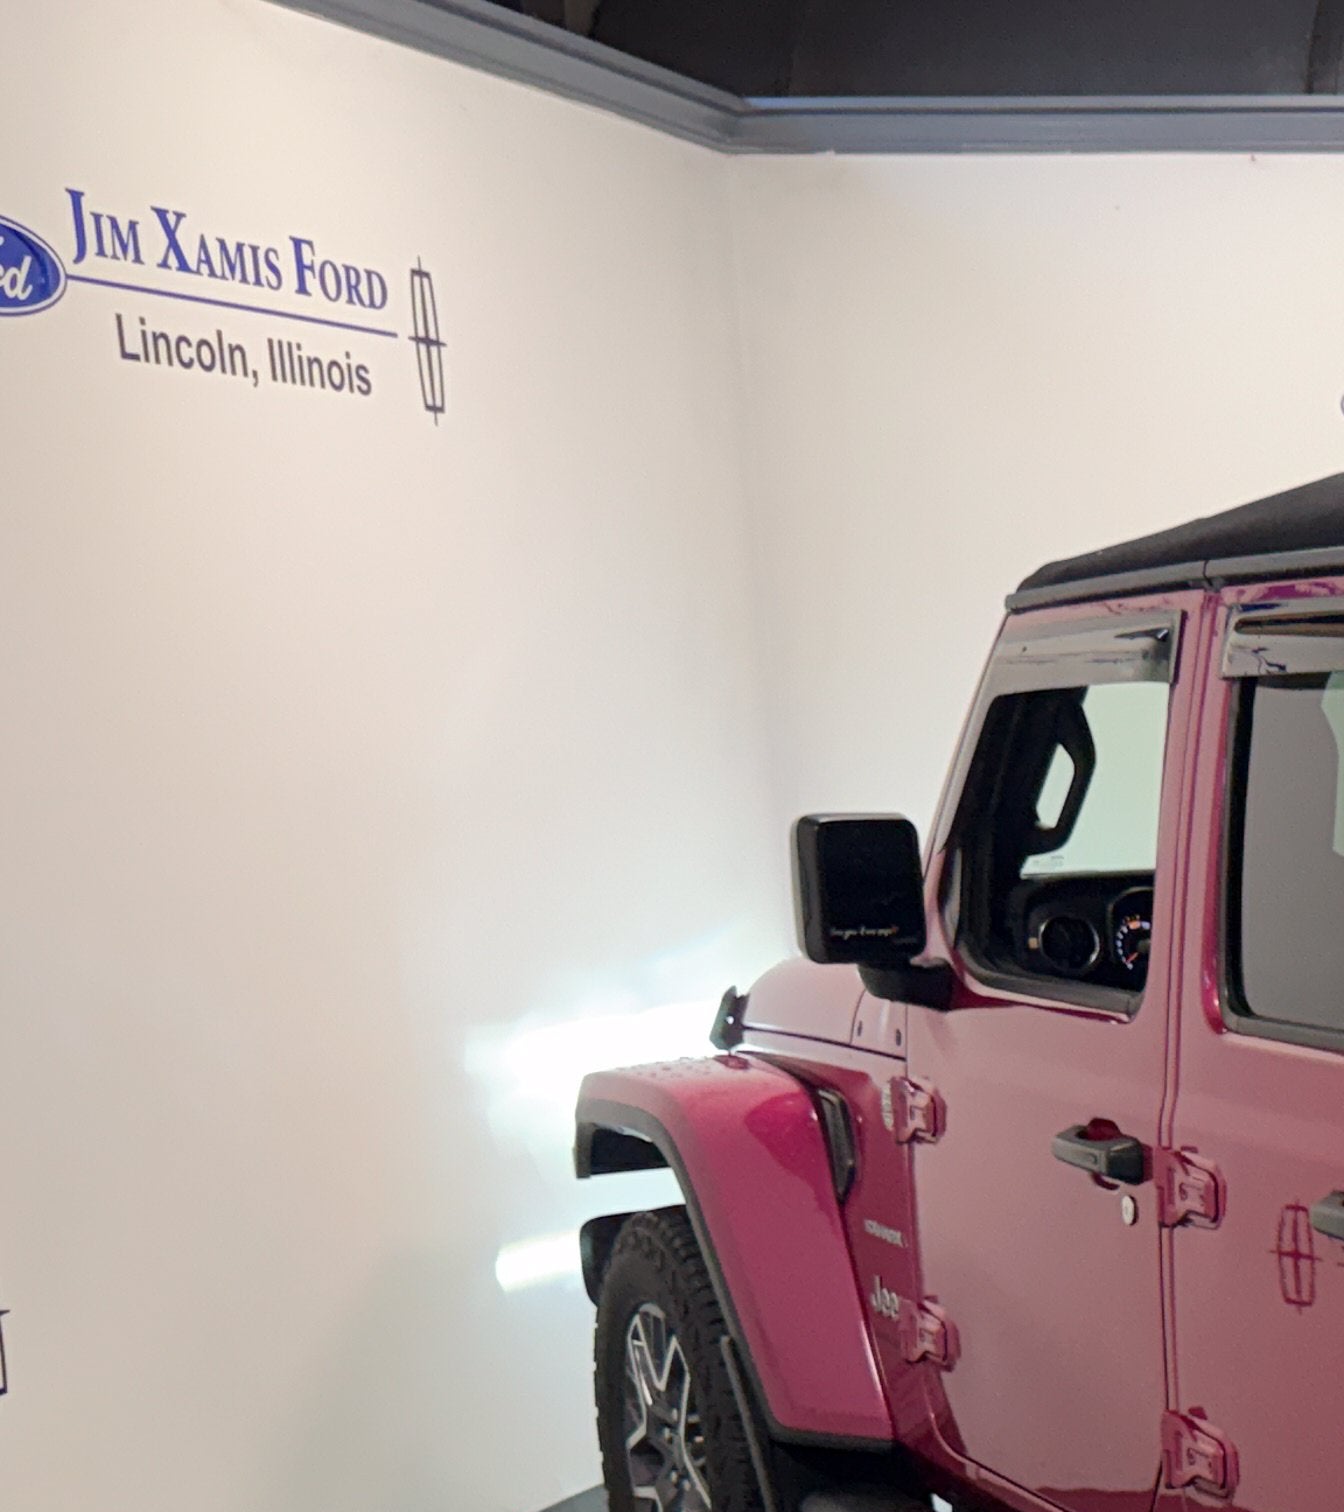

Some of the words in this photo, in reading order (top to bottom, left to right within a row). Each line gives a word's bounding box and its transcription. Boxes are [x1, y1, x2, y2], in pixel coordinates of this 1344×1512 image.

[65, 188, 145, 265] JIM
[151, 206, 283, 292] XAMIS
[289, 236, 389, 310] FORD
[115, 313, 260, 387] Lincoln,
[267, 338, 373, 397] Illinois
